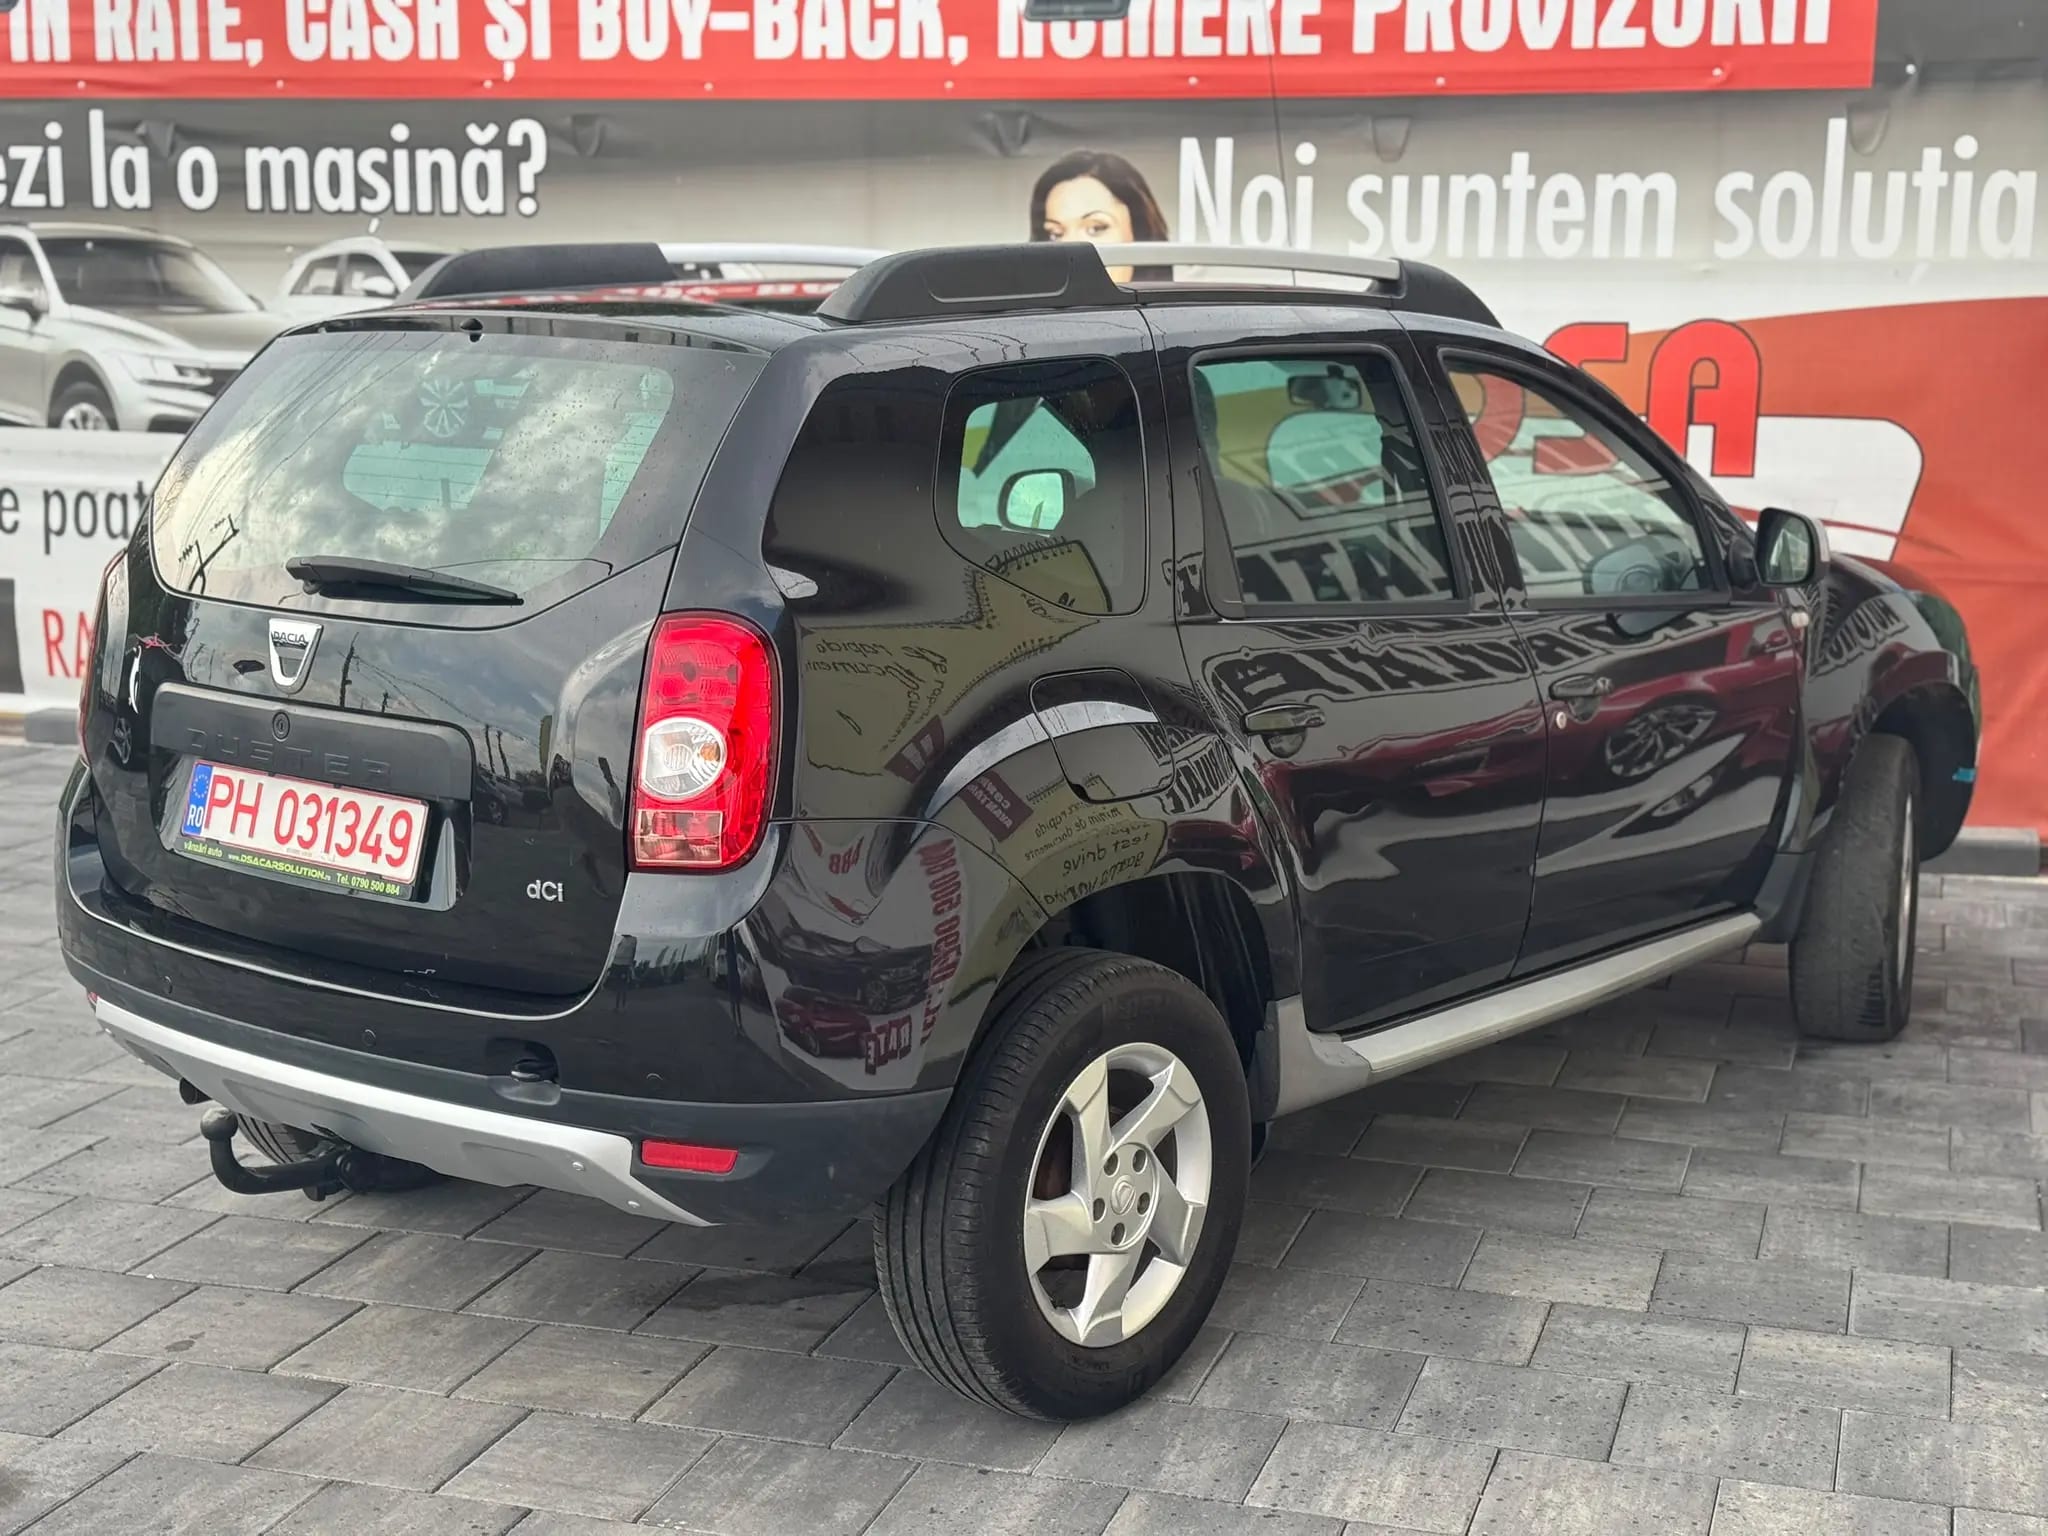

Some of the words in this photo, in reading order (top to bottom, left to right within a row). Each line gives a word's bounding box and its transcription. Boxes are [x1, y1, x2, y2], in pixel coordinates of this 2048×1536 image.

[94, 0, 263, 67] RATE,
[284, 0, 459, 61] CASH
[0, 121, 64, 207] zi
[89, 109, 151, 209] la
[177, 145, 219, 210] o
[1179, 137, 1317, 249] Noi
[1348, 151, 1677, 260] suntem
[272, 631, 306, 643] DACIA
[187, 804, 204, 828] RO
[204, 774, 264, 839] PH
[274, 789, 413, 868] 031349
[351, 876, 370, 889] 0790
[371, 882, 385, 893] 500
[386, 885, 400, 896] 884
[526, 879, 564, 902] dCi
